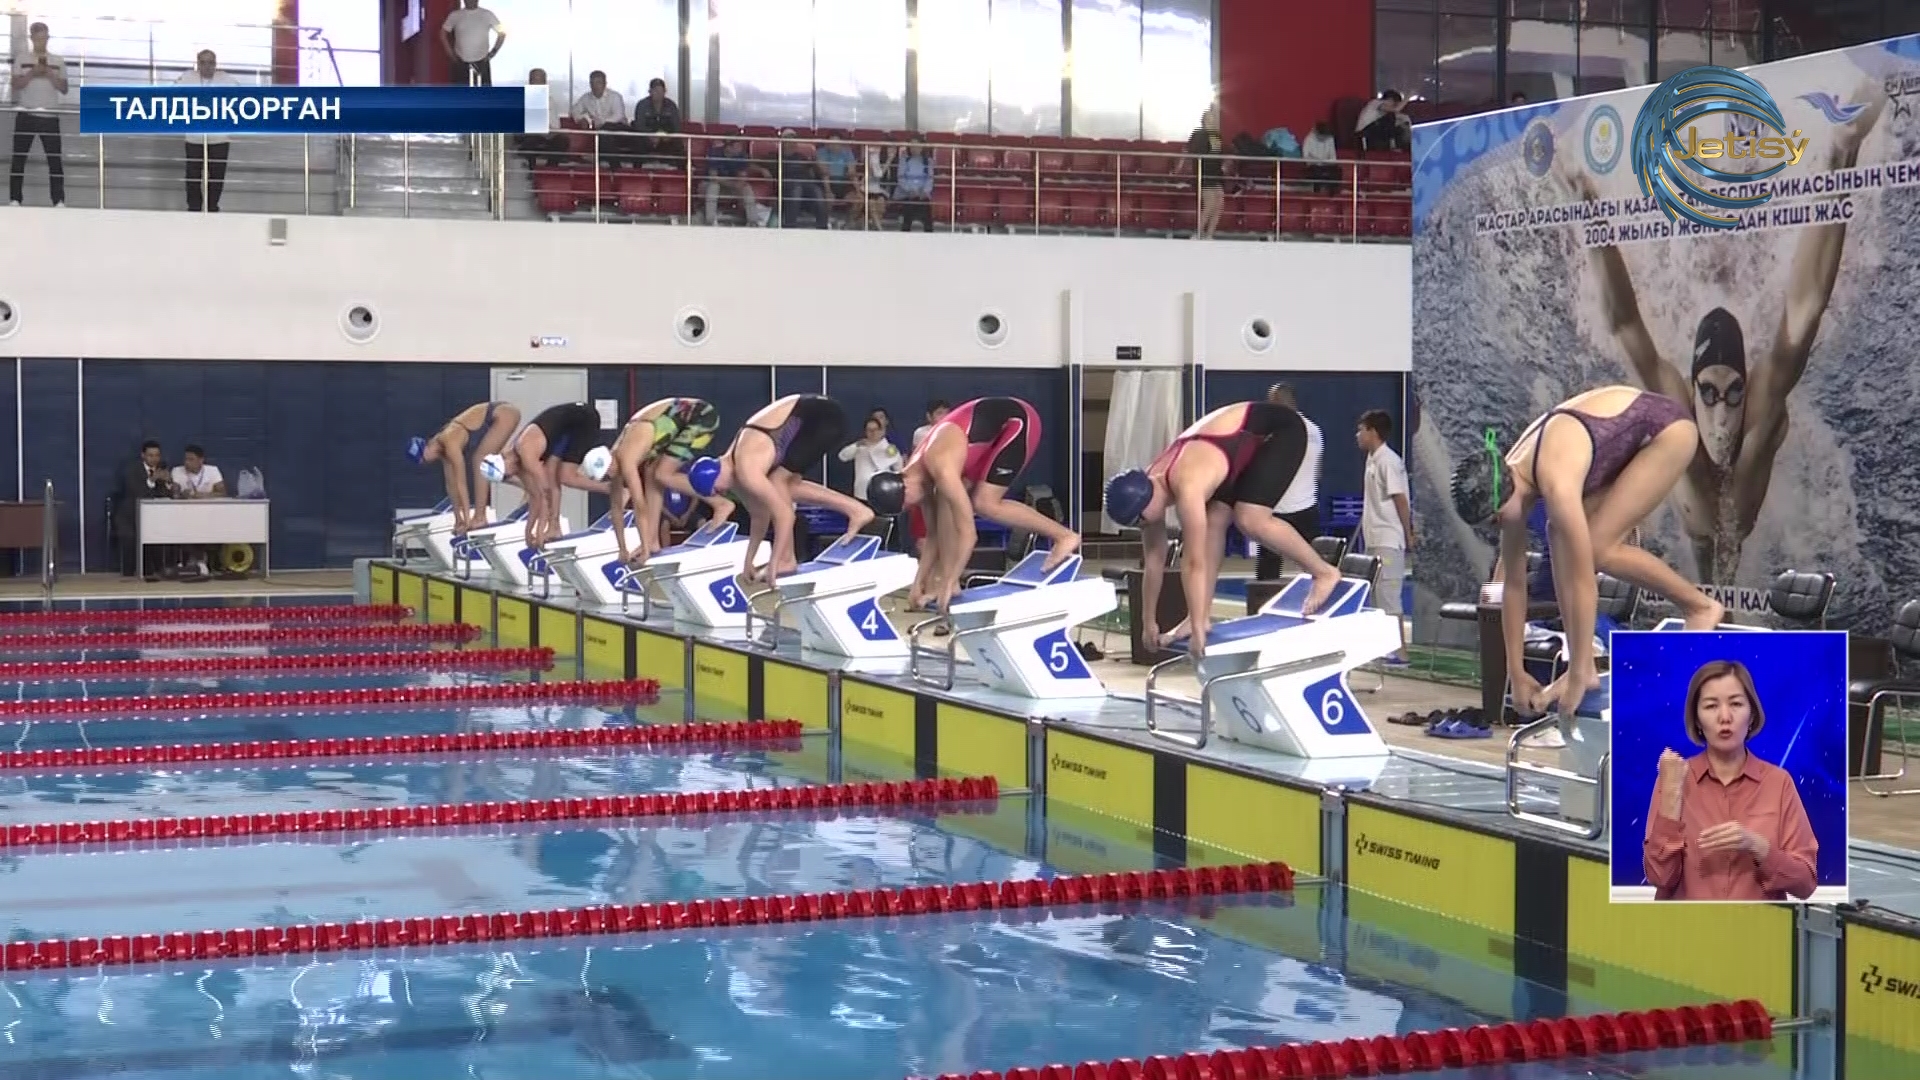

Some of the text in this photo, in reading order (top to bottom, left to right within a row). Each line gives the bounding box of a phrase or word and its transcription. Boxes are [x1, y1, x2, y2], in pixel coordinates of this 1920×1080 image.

[1477, 213, 1526, 231] ЖАСТАР
[1528, 202, 1620, 225] АРАСЫНДАҒЫ
[1585, 228, 1615, 245] 2004
[1619, 222, 1674, 242] ЖЫЛҒЫ
[1773, 205, 1810, 226] КІШІ
[1816, 202, 1853, 220] ЖАС
[614, 567, 627, 588] 2
[721, 585, 736, 608] 3
[861, 608, 879, 635] 4
[1050, 641, 1069, 672] 5
[1231, 695, 1263, 734] 6
[1321, 688, 1345, 726] 6
[1368, 842, 1441, 870] SWISS TIMING
[1884, 977, 1920, 1000] SWI
